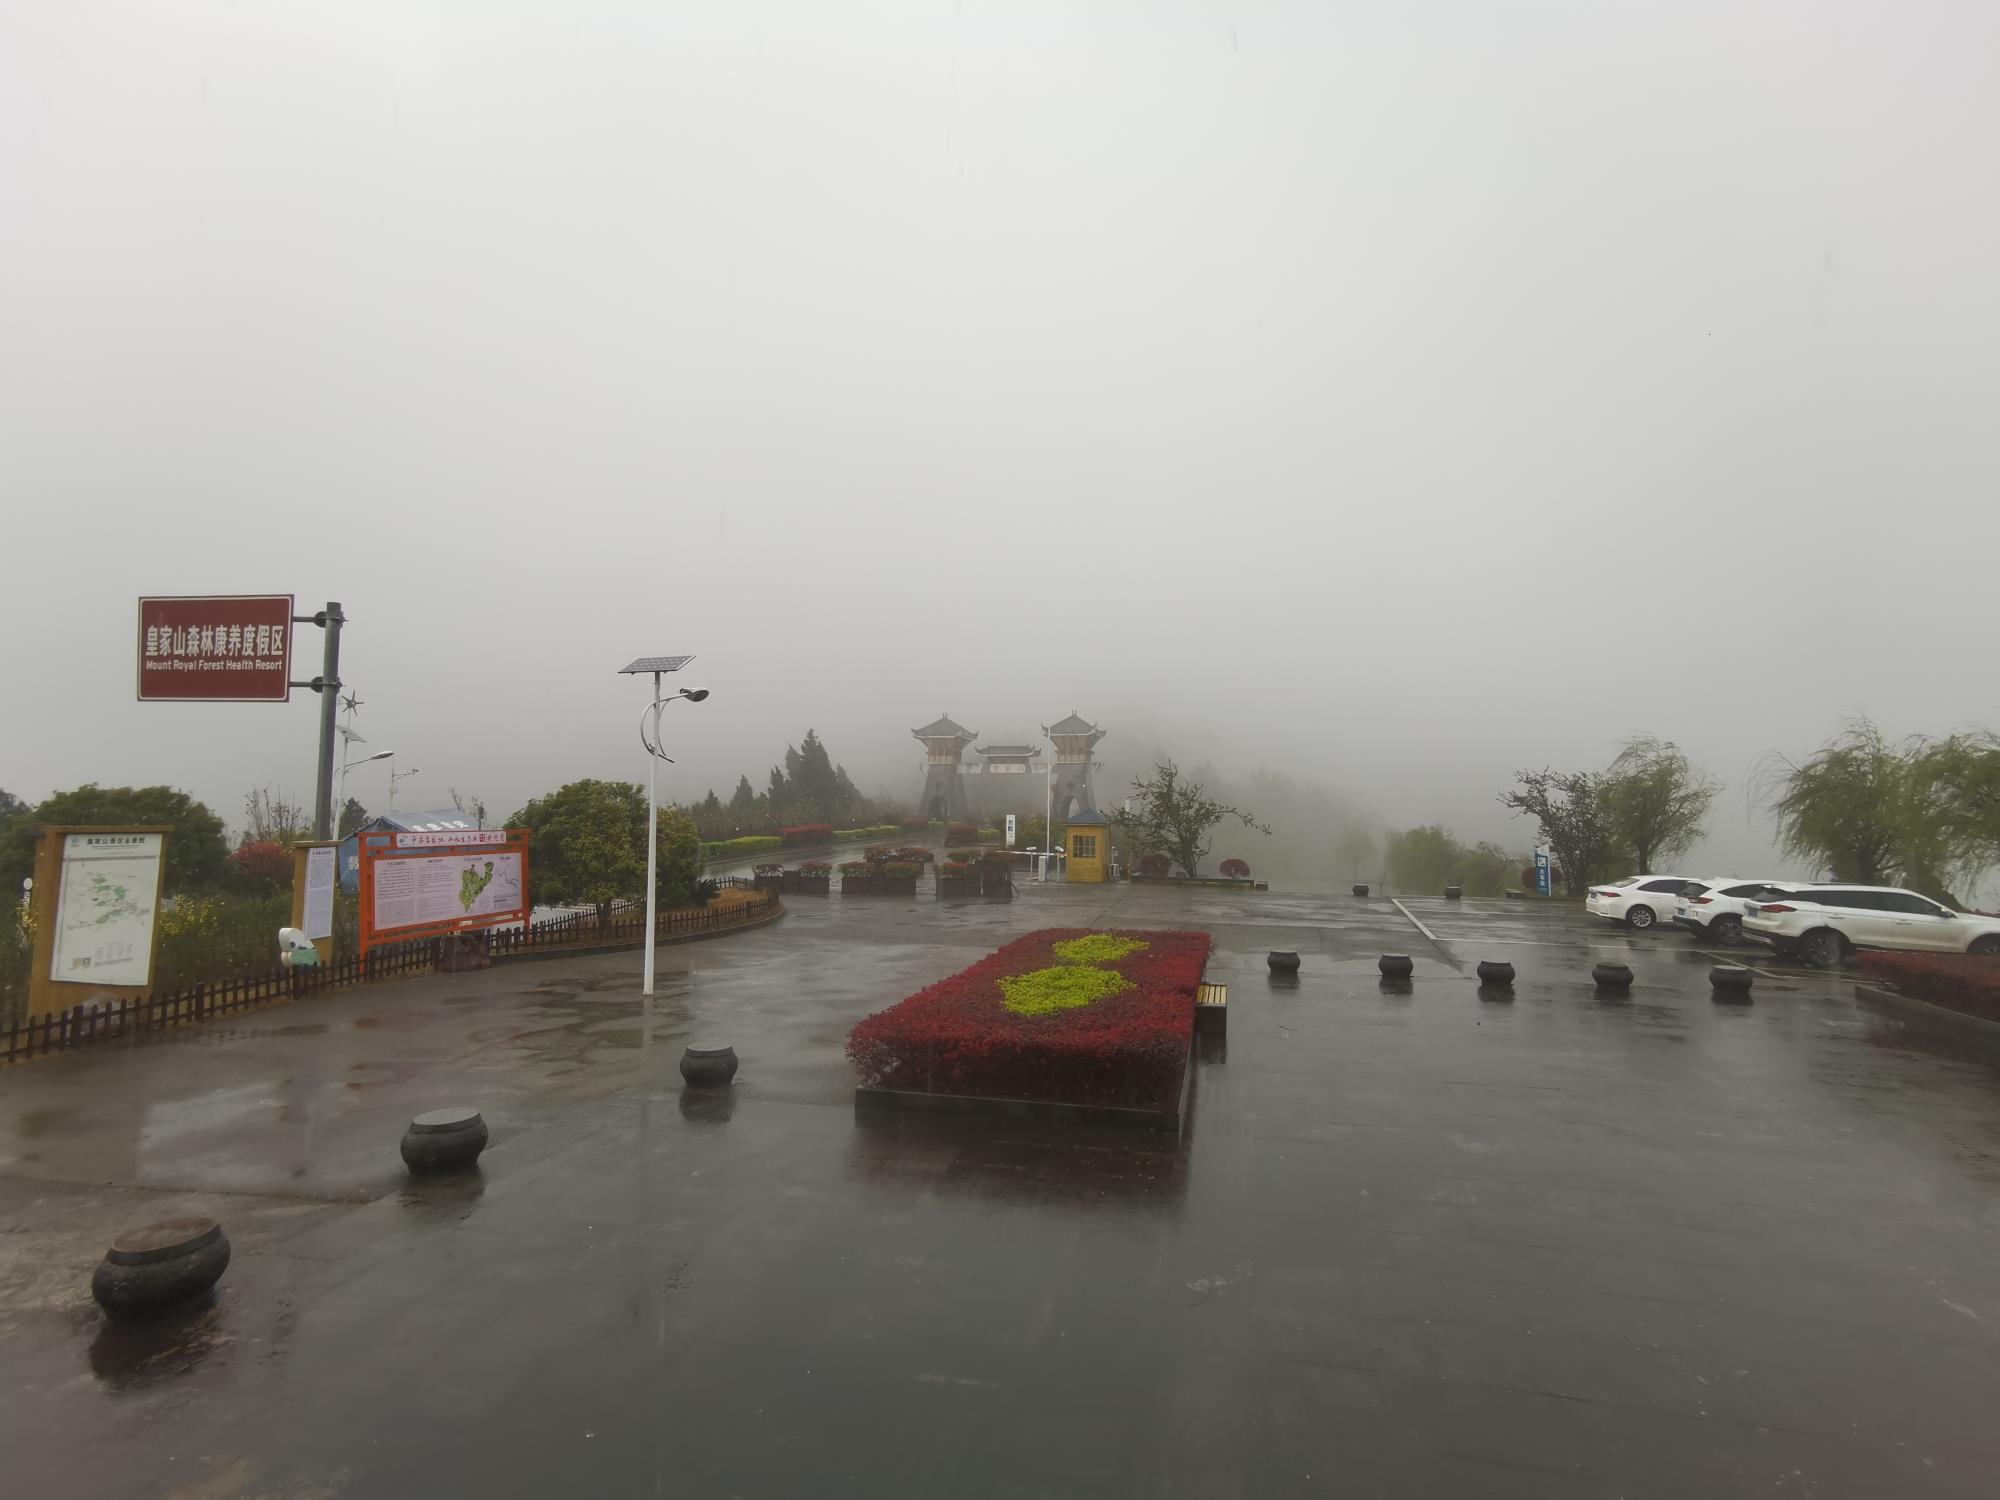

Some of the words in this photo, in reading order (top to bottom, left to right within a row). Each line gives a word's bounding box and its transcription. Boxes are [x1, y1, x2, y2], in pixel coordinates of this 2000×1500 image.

[145, 624, 284, 657] 皇家山森林康养度假区
[146, 660, 172, 671] Mount
[173, 659, 197, 672] Royal
[198, 659, 225, 670] Forest
[226, 659, 254, 670] Health
[255, 659, 283, 671] Resort
